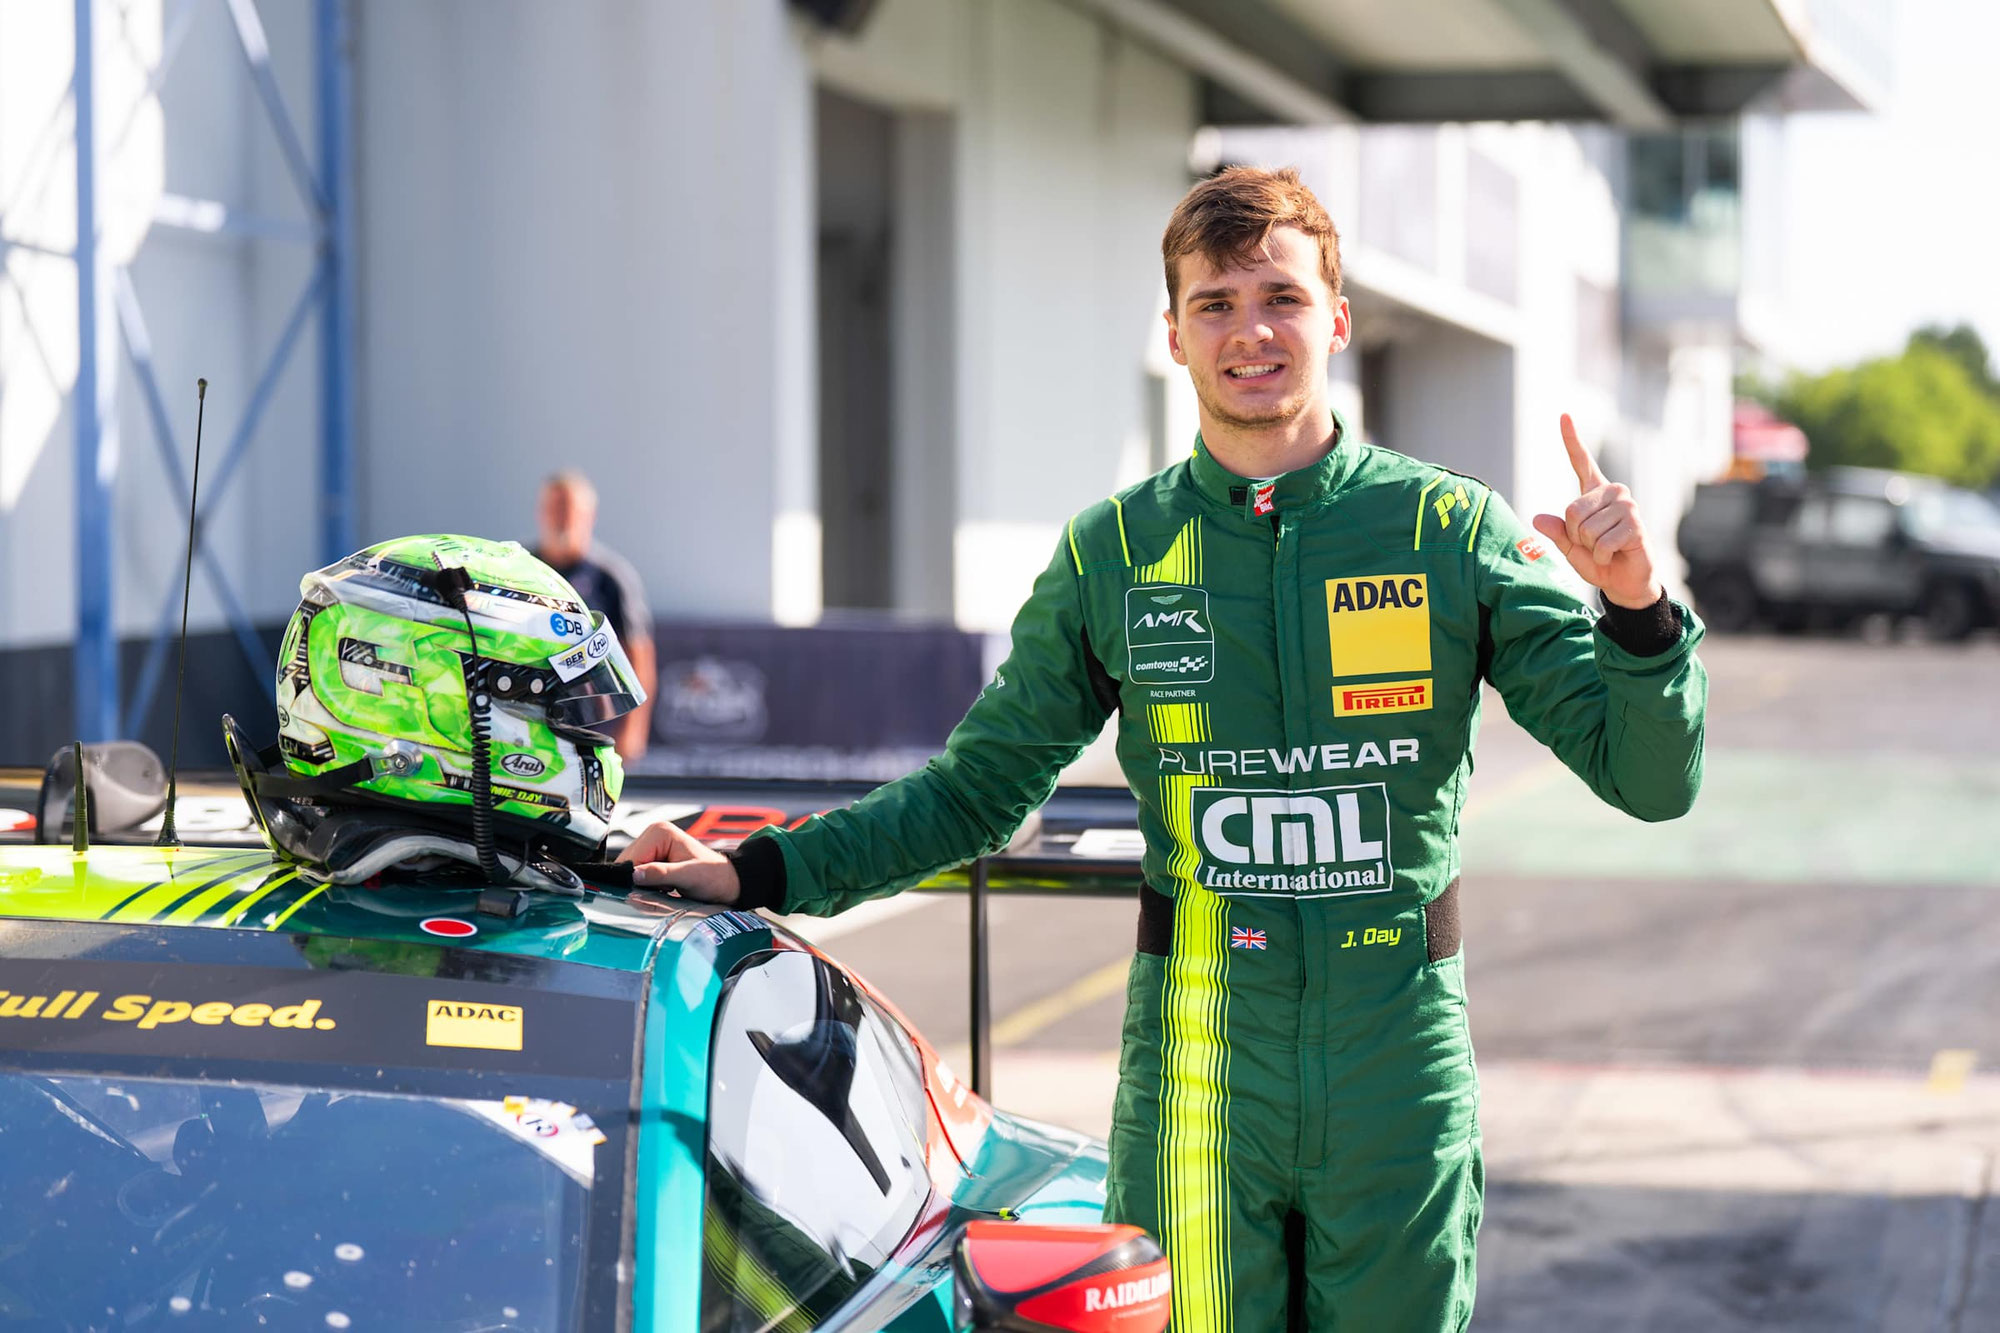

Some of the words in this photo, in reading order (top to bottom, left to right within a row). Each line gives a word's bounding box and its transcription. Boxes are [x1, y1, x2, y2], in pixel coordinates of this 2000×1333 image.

[1433, 484, 1470, 529] P1
[1333, 578, 1424, 613] ADAC
[554, 617, 583, 636] 3DB
[1133, 609, 1206, 634] AMR
[565, 651, 584, 667] BER
[1135, 660, 1179, 671] comtoyou
[1150, 690, 1164, 698] RACE
[1165, 689, 1196, 698] PARTNER
[1342, 685, 1425, 711] PIRELLI
[505, 755, 541, 773] Arai
[1158, 738, 1420, 776] PUREWEAR
[516, 790, 543, 803] DAY
[1204, 861, 1386, 892] International
[1340, 930, 1358, 949] J.
[1362, 927, 1402, 947] Day
[101, 994, 337, 1031] Speed.
[435, 1005, 517, 1022] ADAC
